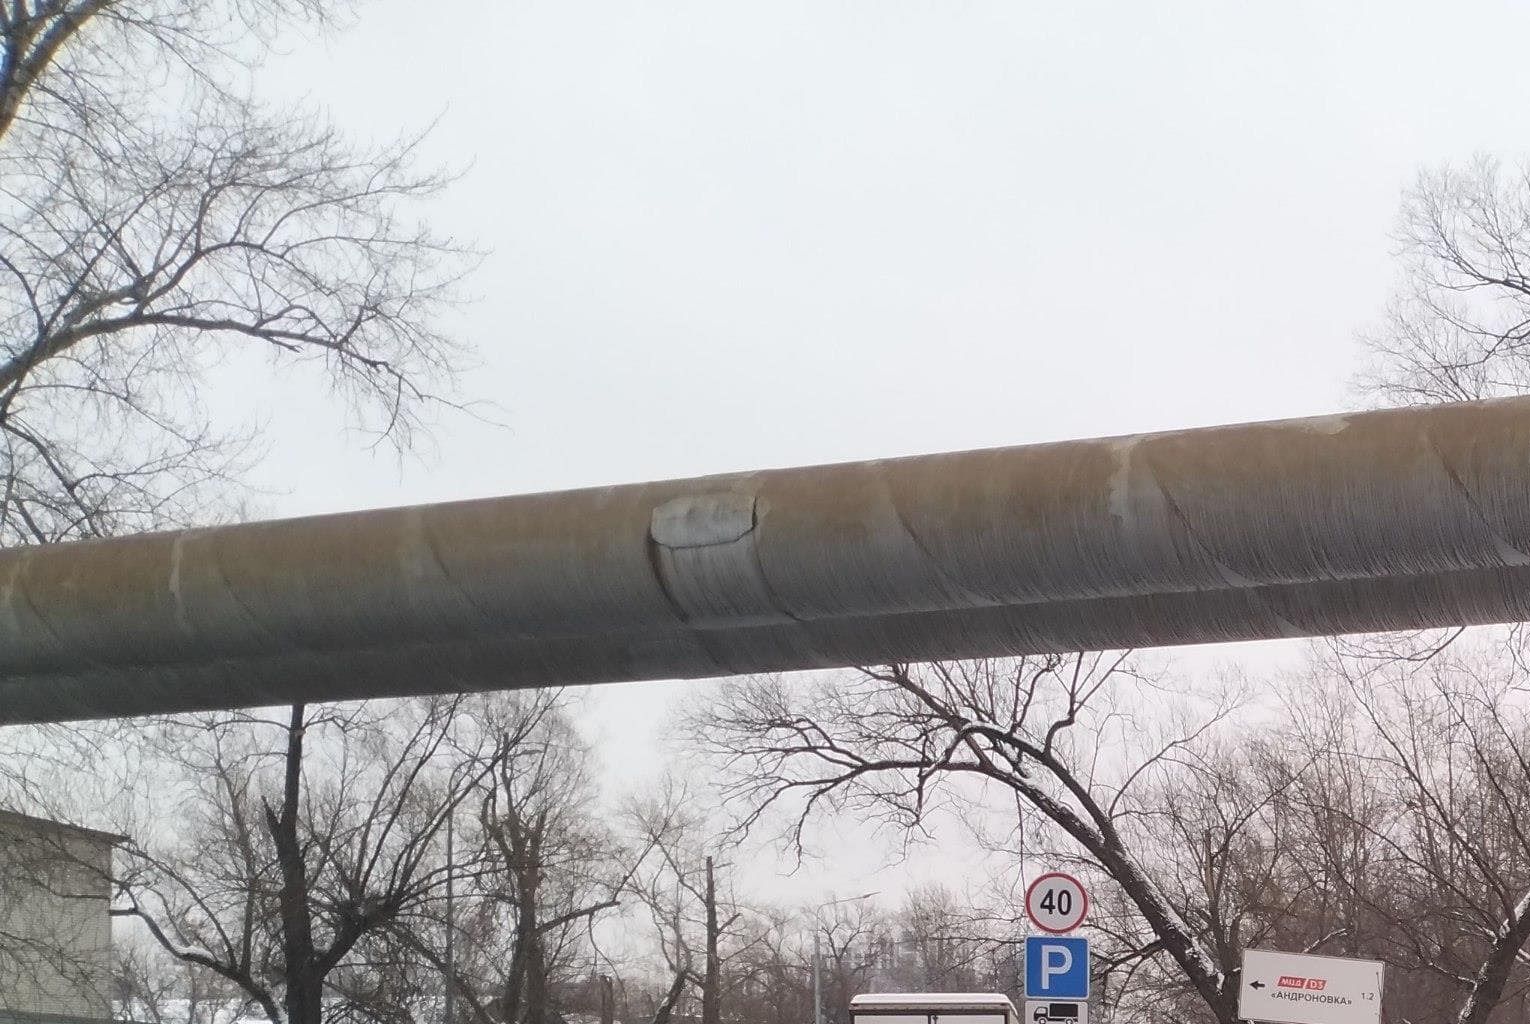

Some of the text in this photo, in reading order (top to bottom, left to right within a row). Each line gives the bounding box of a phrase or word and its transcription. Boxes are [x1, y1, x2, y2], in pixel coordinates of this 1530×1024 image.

[1039, 888, 1073, 916] 40
[1041, 944, 1074, 990] P
[1271, 991, 1353, 1006] «АНДРОНОВКА»
